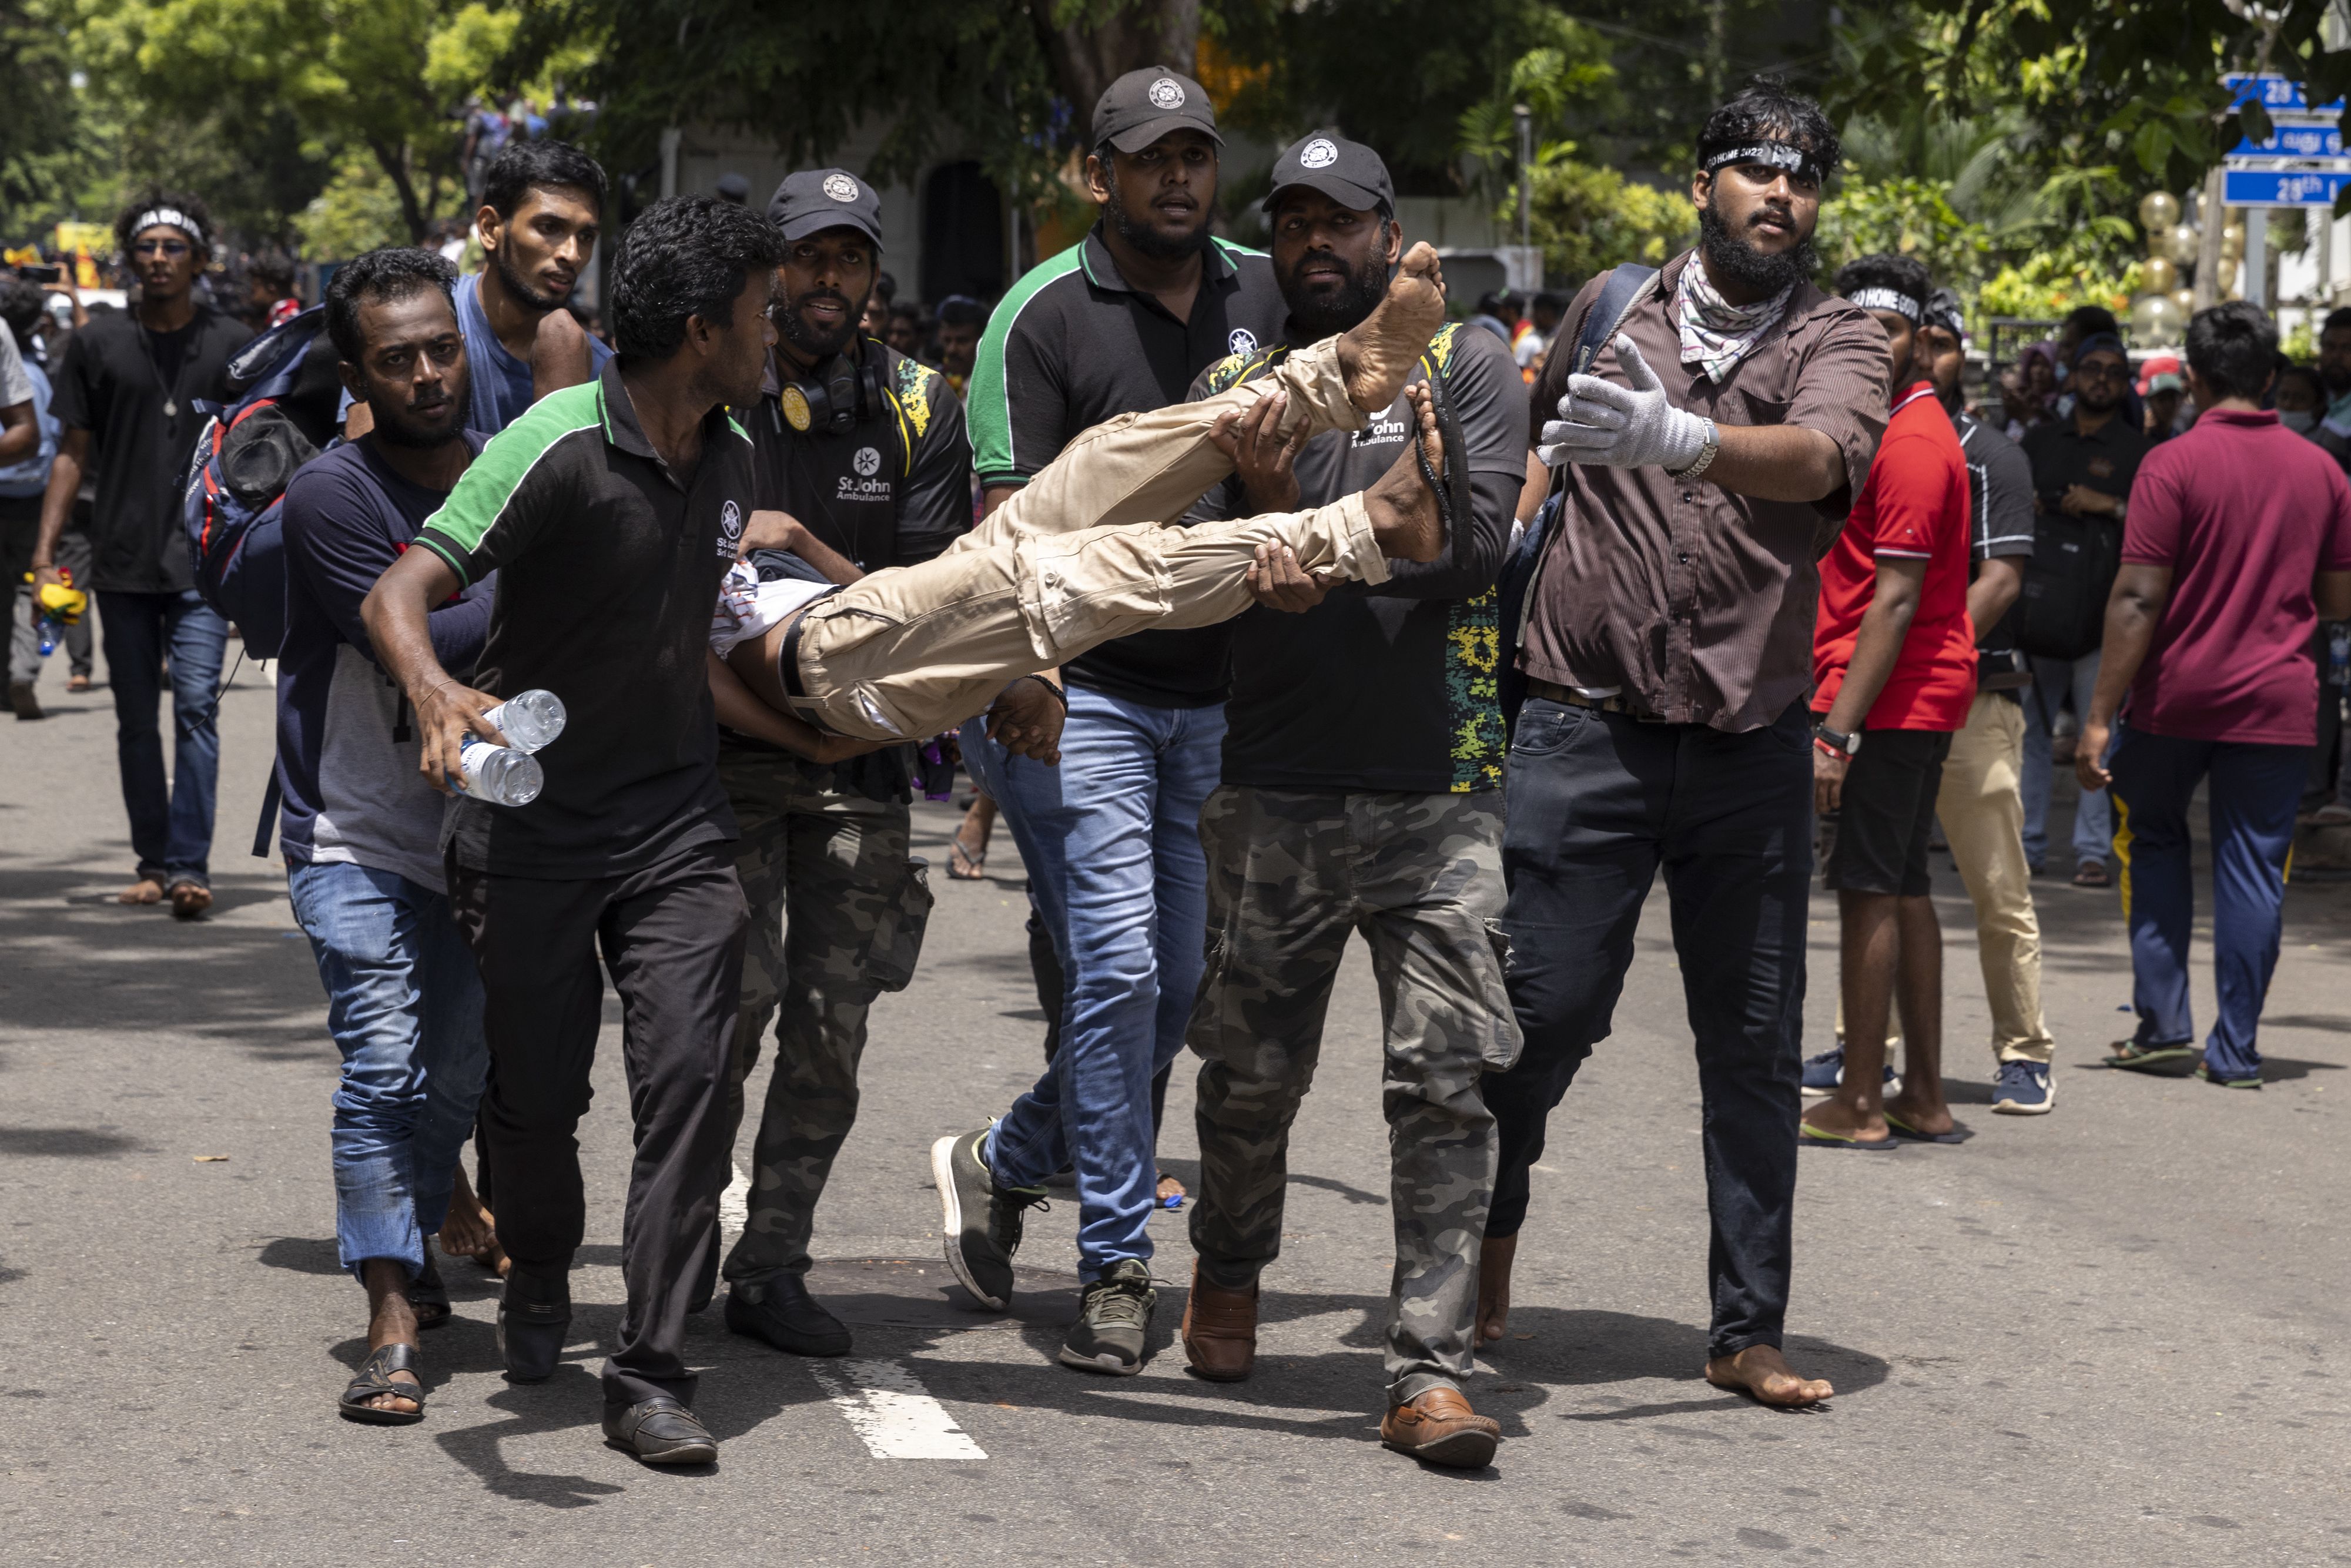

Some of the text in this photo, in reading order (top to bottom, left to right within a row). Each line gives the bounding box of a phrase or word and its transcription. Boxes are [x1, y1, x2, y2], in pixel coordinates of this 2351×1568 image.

[1707, 156, 1717, 168] GO
[1717, 149, 1739, 164] HOME
[1740, 147, 1764, 158] 2022
[1865, 287, 1900, 310] HOME
[838, 476, 891, 493] St John
[836, 491, 890, 501] Ambulance
[716, 537, 727, 547] St
[716, 548, 727, 557] Sri
